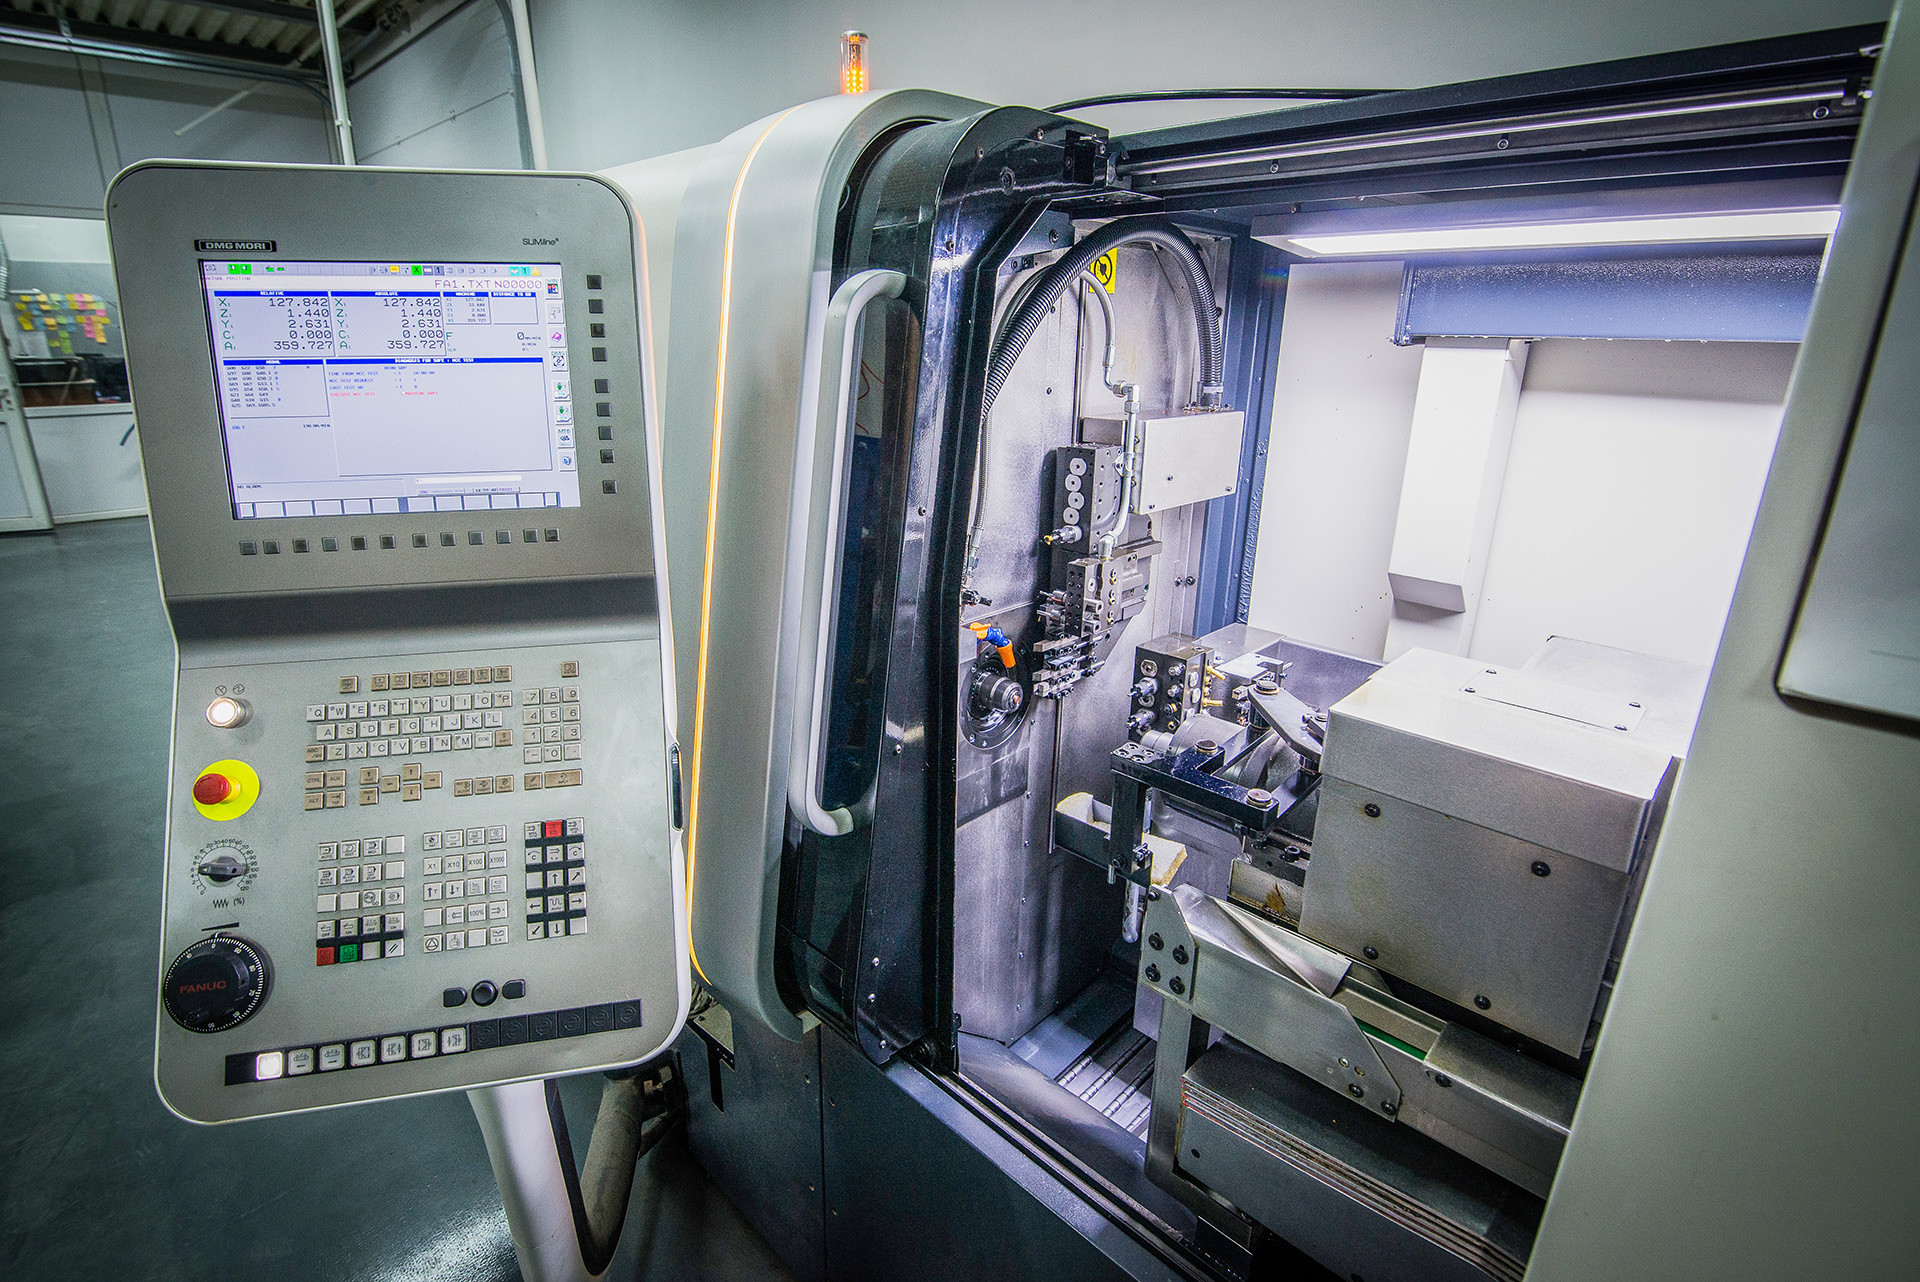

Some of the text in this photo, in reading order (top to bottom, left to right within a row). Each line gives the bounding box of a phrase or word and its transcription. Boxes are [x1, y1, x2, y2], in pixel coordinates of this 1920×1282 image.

[434, 280, 542, 289] FA1.TXT N00000
[269, 298, 328, 306] 127.842
[384, 298, 440, 306] 127.842
[288, 309, 329, 318] 1.440
[401, 309, 441, 318] 1.440
[288, 320, 330, 328] 2.631
[402, 320, 441, 328] 2.631
[290, 330, 332, 339] 0.000
[403, 330, 443, 338] 0.000
[517, 332, 524, 340] 0
[274, 341, 332, 350] 359.727
[388, 341, 444, 349] 359.727
[180, 980, 227, 994] FANUC
